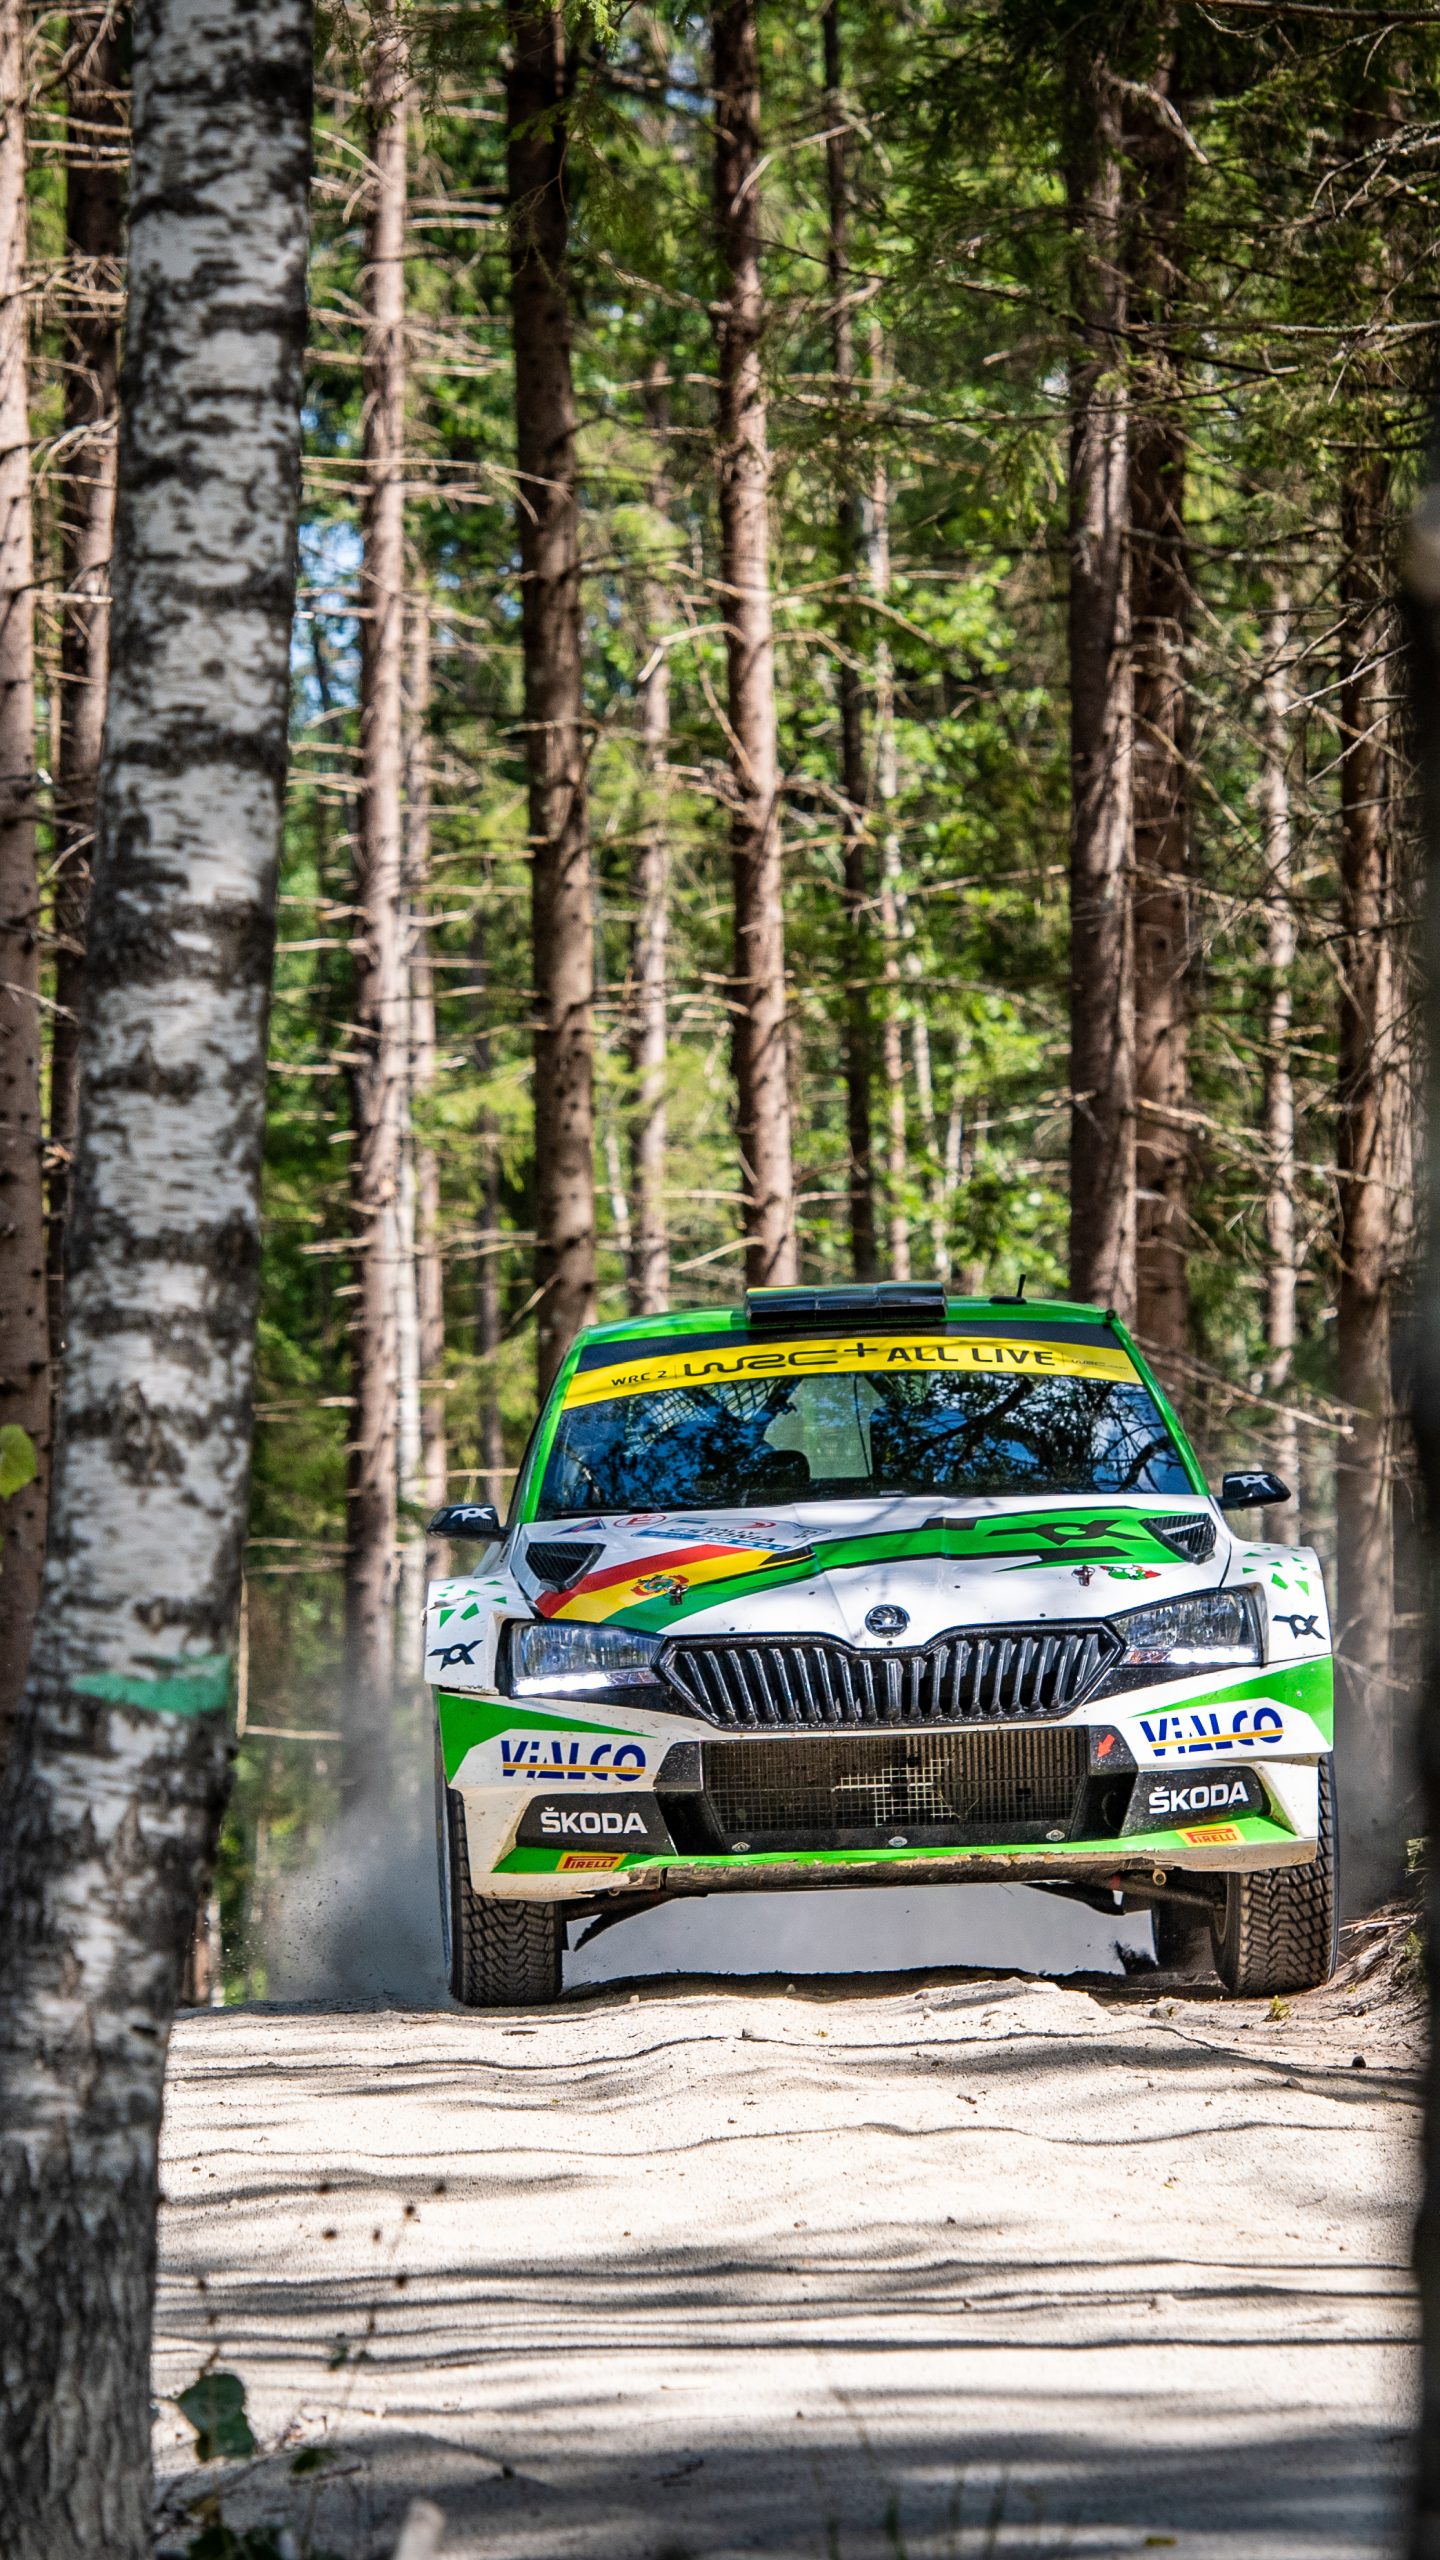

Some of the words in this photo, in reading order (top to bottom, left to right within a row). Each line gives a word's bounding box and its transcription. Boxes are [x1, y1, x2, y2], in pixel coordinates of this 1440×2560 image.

[887, 1347, 959, 1362] ALL
[972, 1347, 1055, 1366] LIVE
[611, 1372, 651, 1386] WRC
[657, 1370, 667, 1379] 2
[668, 1527, 777, 1543] ESTONIA
[1149, 1781, 1249, 1814] ŠKODA
[540, 1807, 648, 1834] ŠKODA
[1185, 1828, 1238, 1844] PIRELLI
[563, 1855, 618, 1869] PIRELLI
